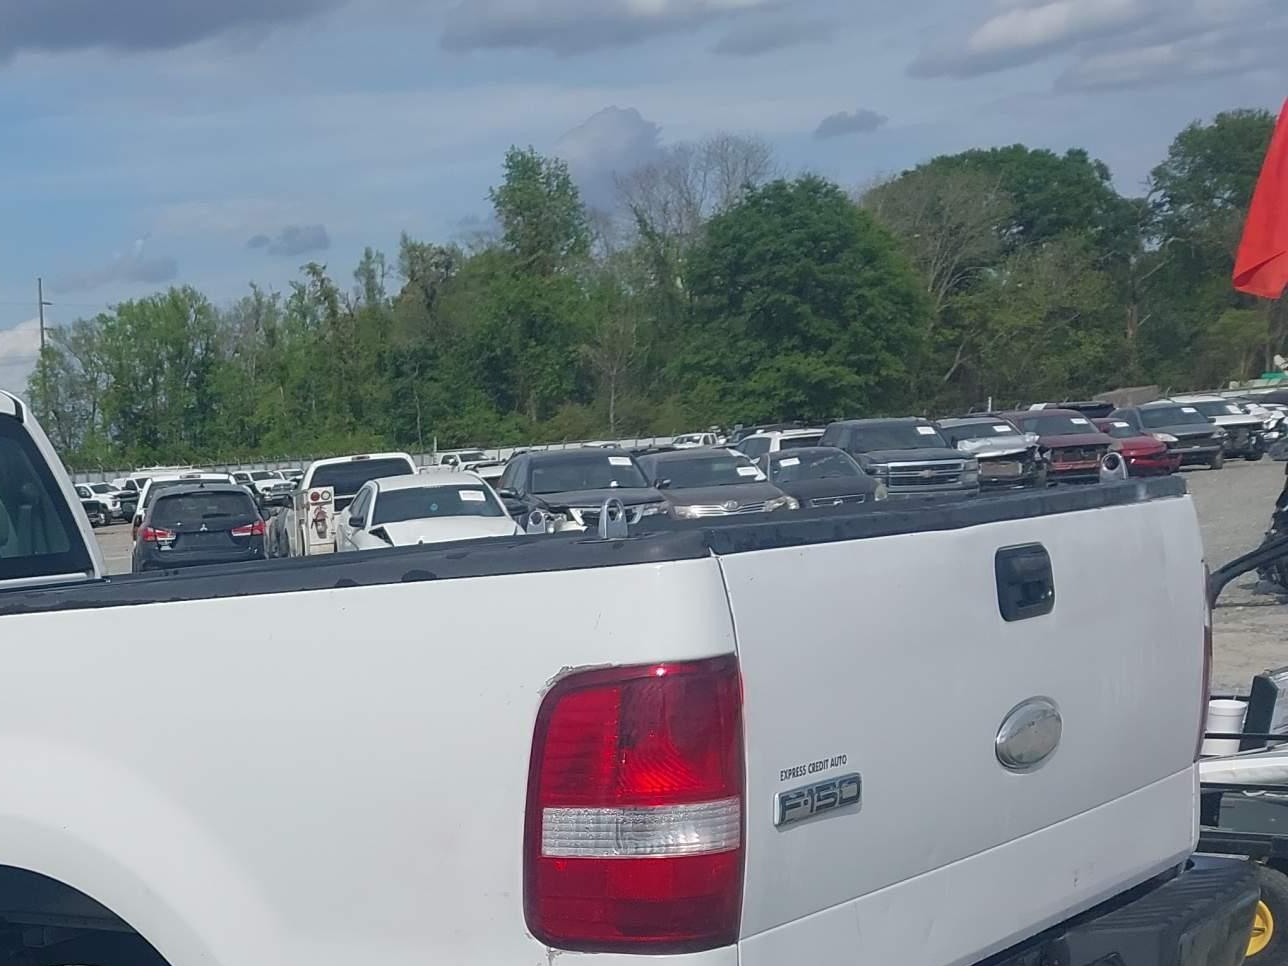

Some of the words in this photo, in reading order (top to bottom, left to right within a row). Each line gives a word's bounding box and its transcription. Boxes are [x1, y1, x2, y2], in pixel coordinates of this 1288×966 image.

[780, 764, 807, 782] EXPRESS
[808, 759, 829, 774] CREDIT
[830, 754, 848, 767] AUTO
